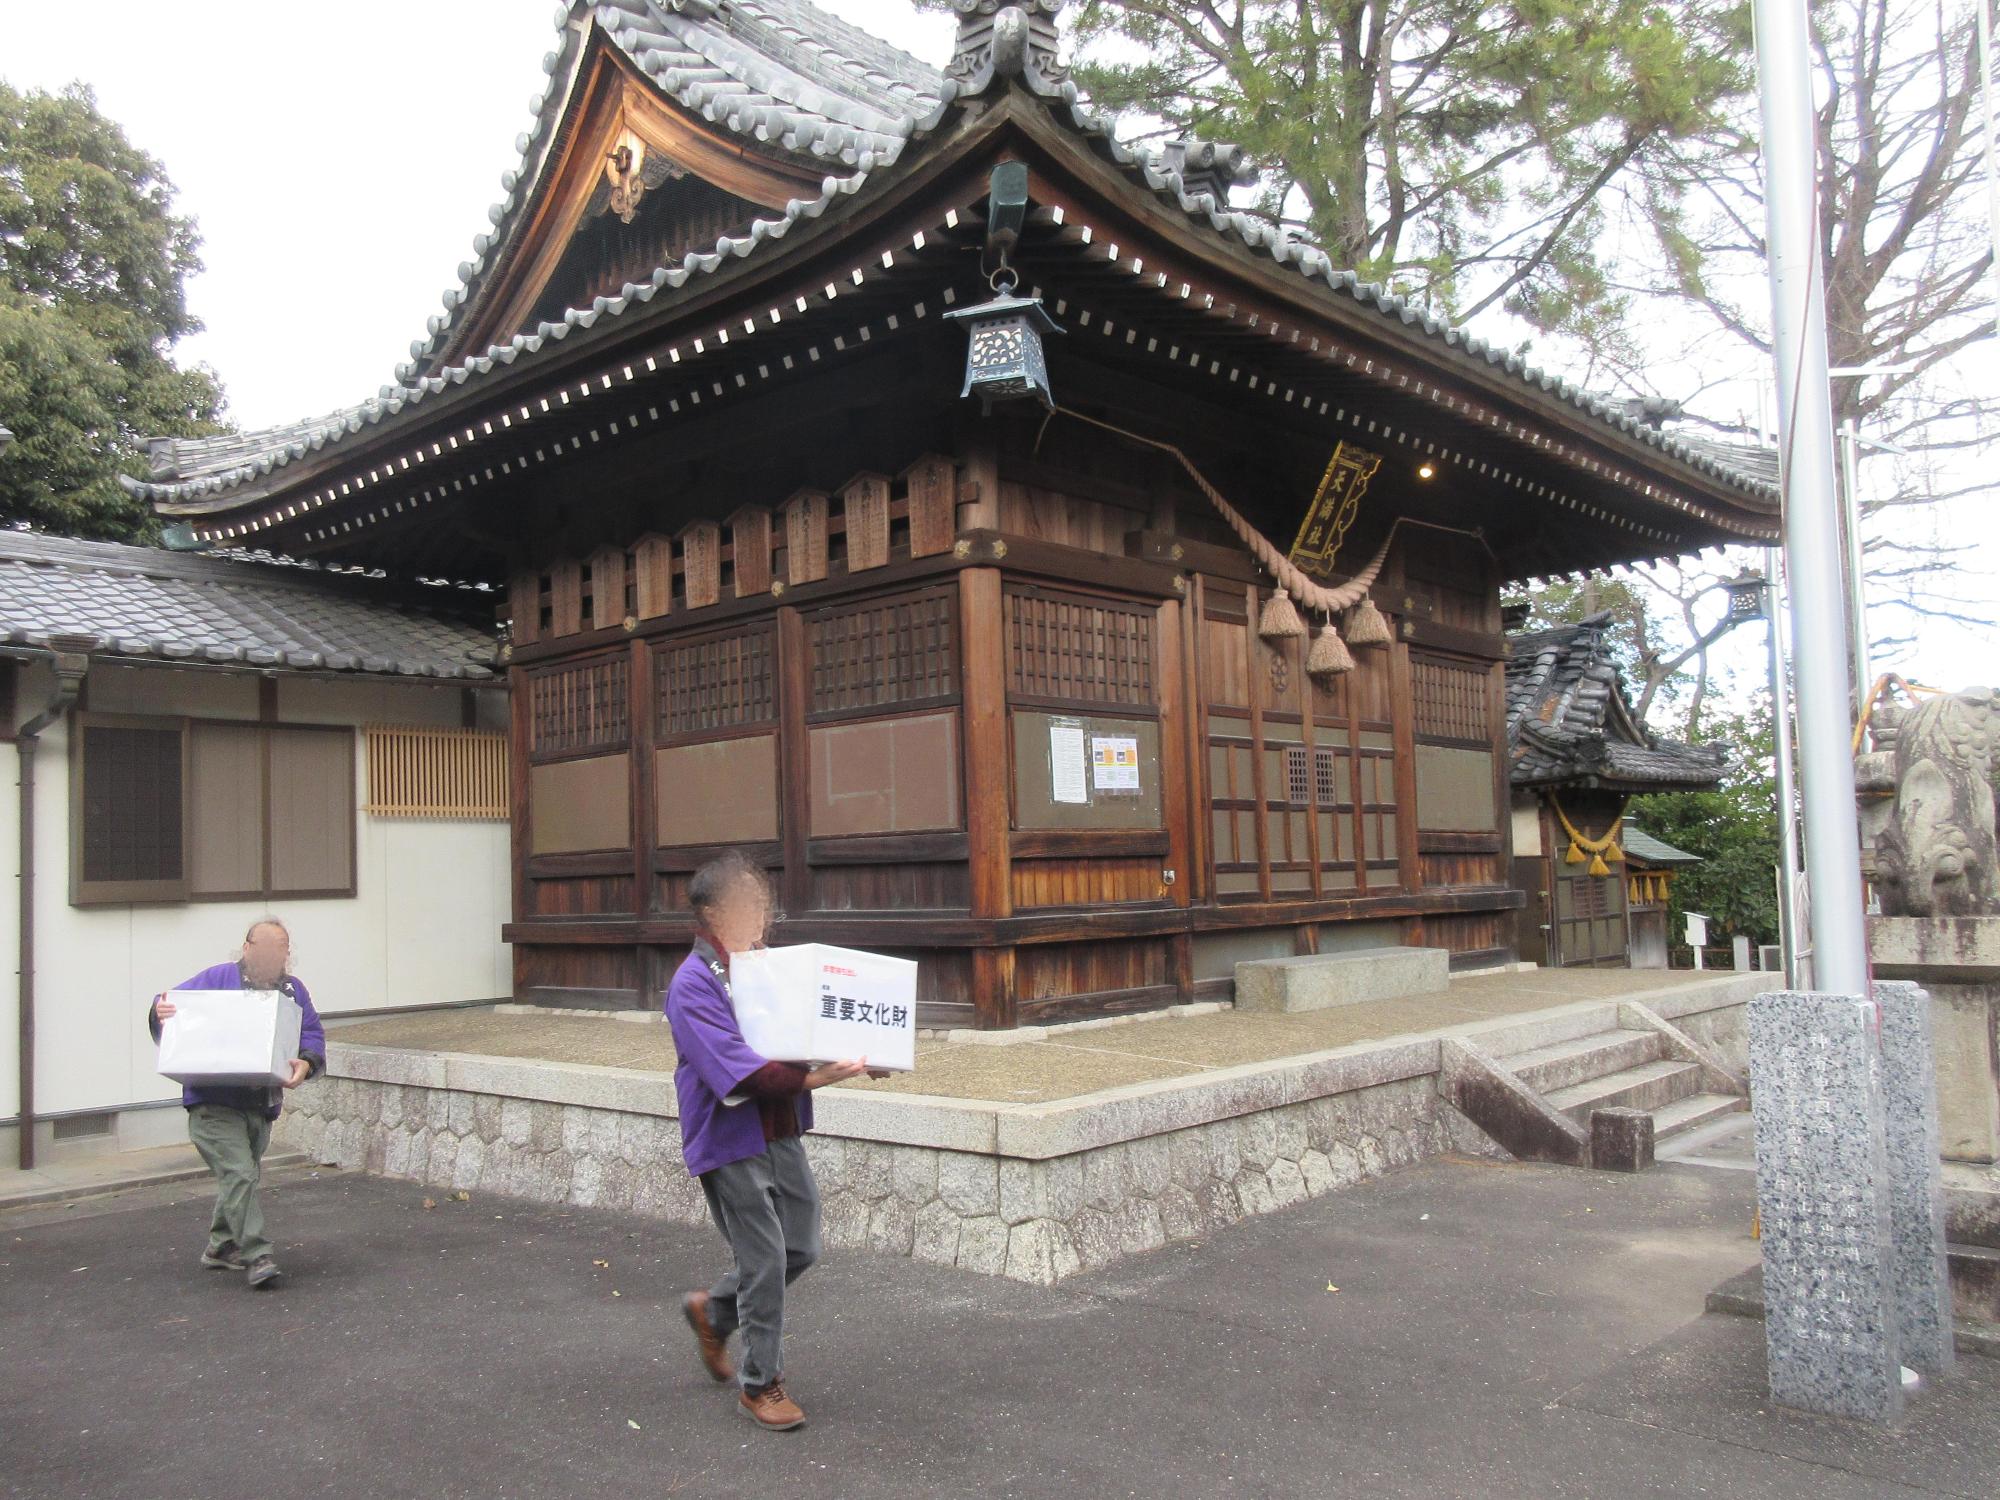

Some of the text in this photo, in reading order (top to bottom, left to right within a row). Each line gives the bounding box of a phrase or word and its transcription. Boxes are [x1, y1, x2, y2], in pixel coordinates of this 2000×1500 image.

[821, 994, 908, 1028] 重要文化財
